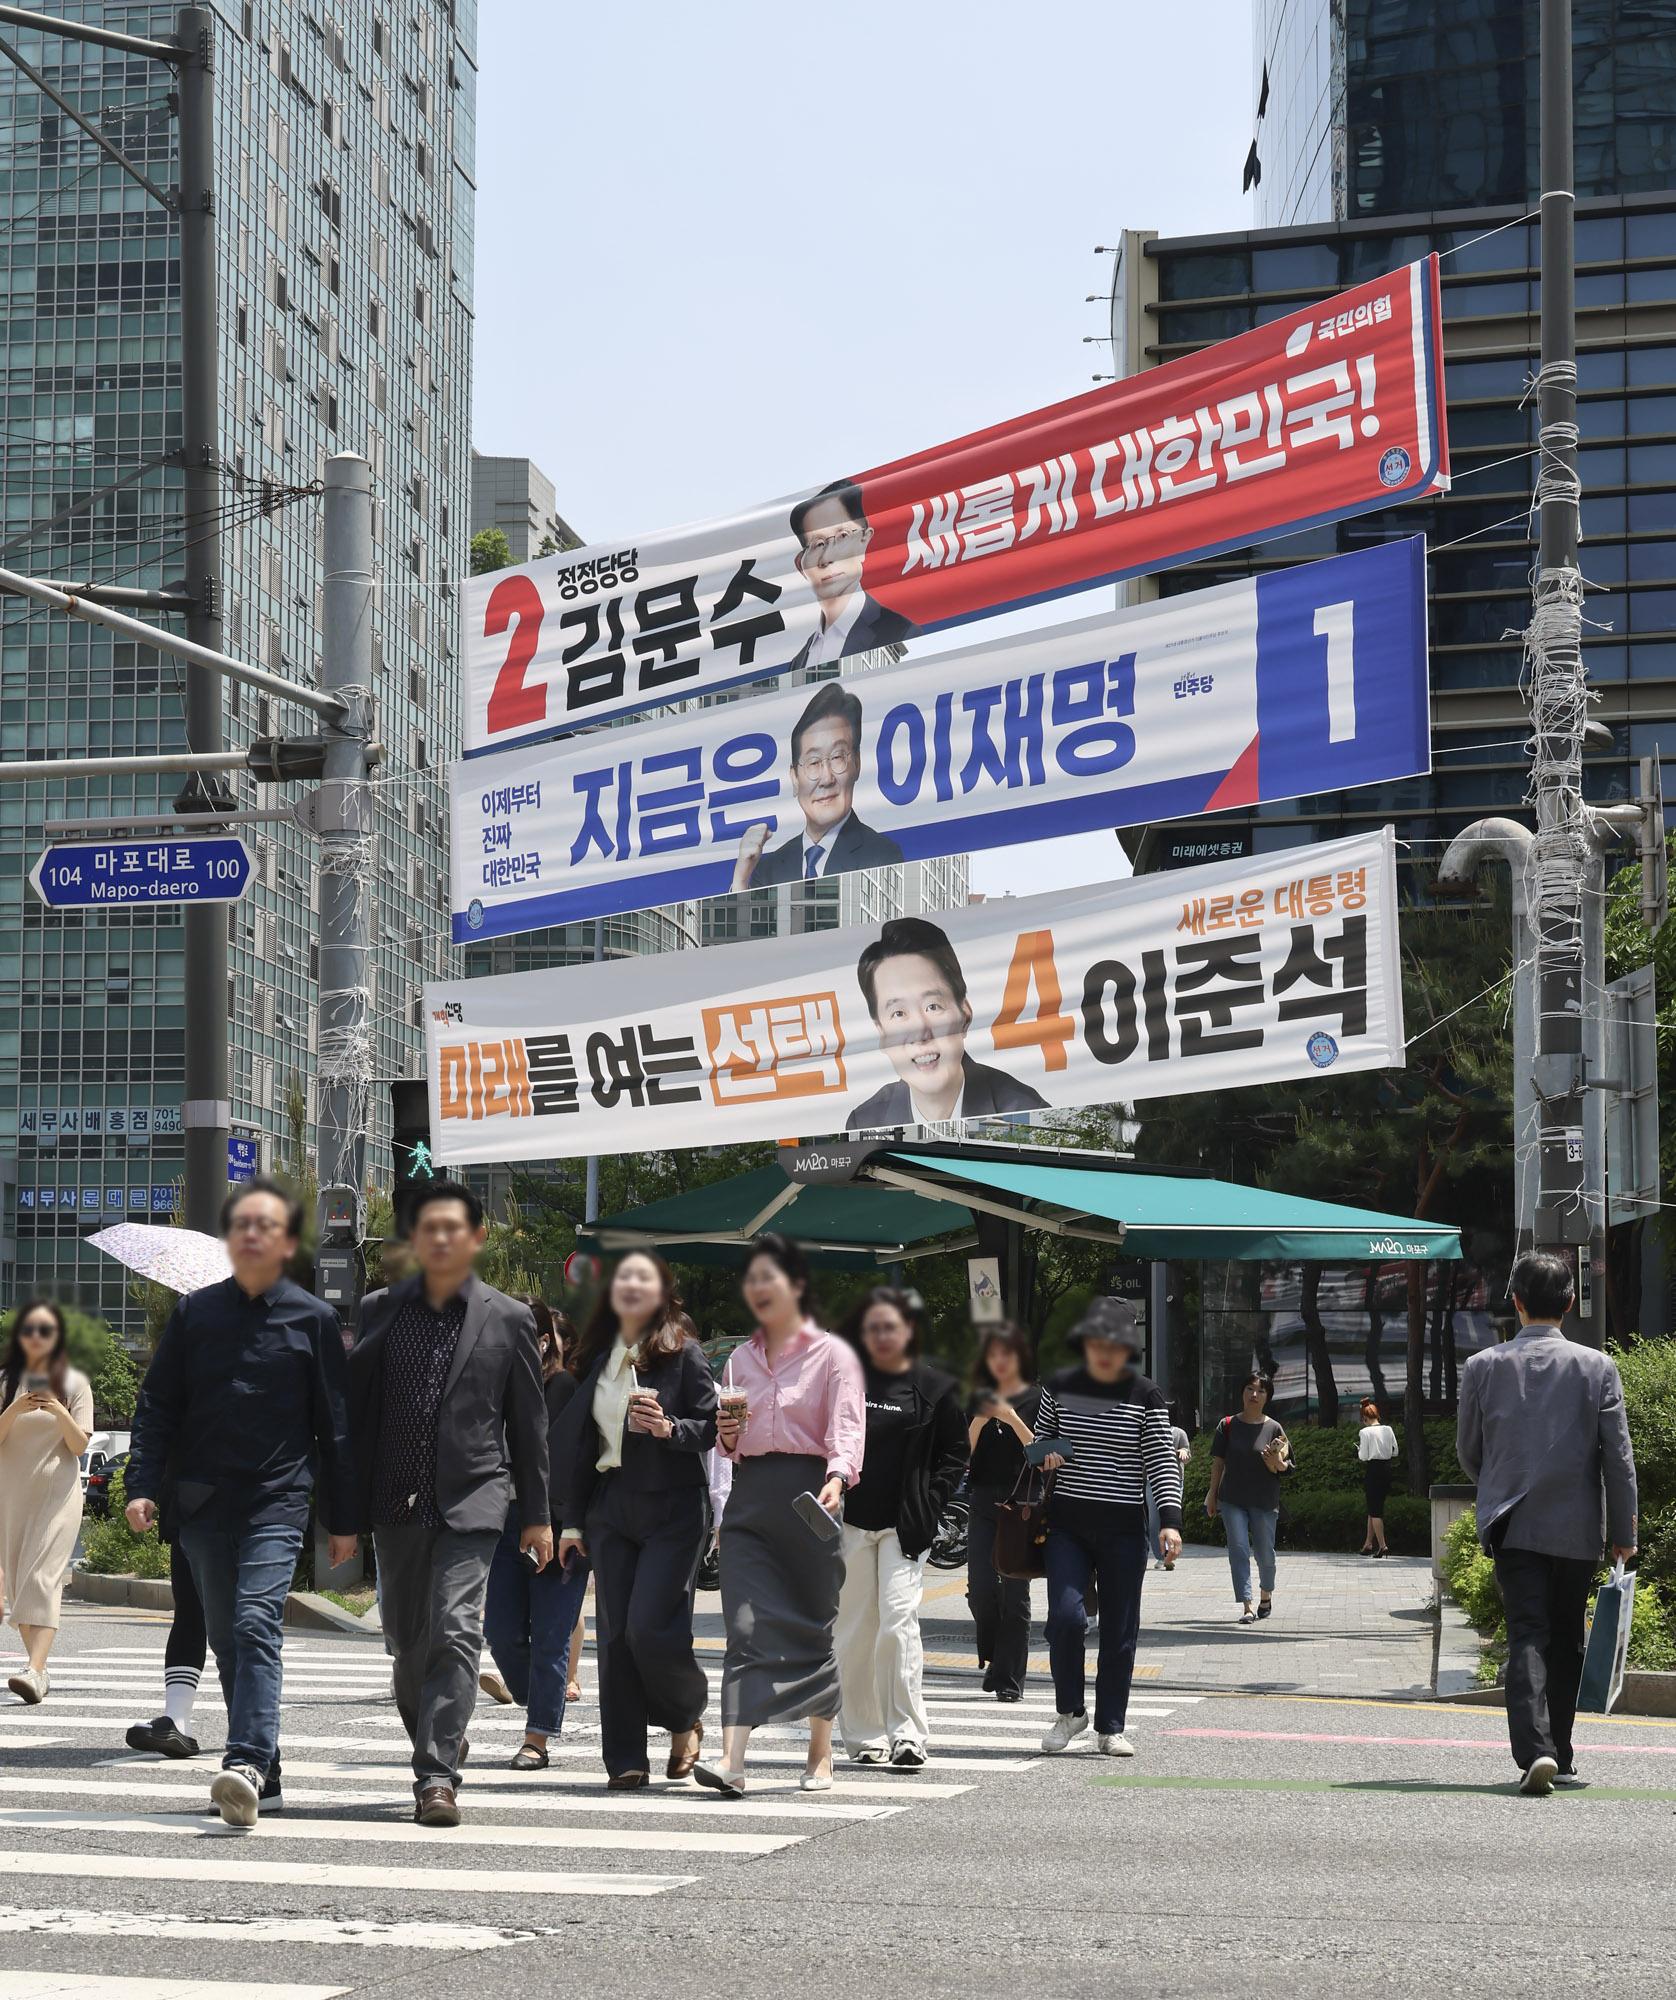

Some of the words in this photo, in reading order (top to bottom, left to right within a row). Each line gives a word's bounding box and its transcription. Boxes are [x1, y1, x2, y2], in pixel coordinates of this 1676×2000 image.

[1317, 294, 1392, 341] 국민의힘
[902, 453, 1079, 575] 새롭게
[1089, 355, 1381, 518] 대한민국!
[557, 548, 639, 600] 정정당당
[483, 575, 547, 735] 2
[560, 558, 786, 712] 김문수
[1173, 674, 1215, 700] 민주당
[1313, 600, 1357, 744] 1
[570, 733, 781, 867] 지금은
[876, 652, 1137, 807] 이재명
[481, 780, 542, 820] 이제부터
[482, 823, 513, 854] 진짜
[1172, 841, 1244, 858] 미래에셋증권
[49, 866, 83, 887] 104
[94, 847, 196, 876] 마포대로
[206, 859, 240, 880] 100
[482, 852, 542, 889] 대한민국
[91, 879, 200, 900] Mapo-daero
[1176, 888, 1265, 937] 새로운
[1273, 867, 1367, 920] 대통령
[991, 929, 1075, 1073] 4
[1081, 914, 1368, 1065] 이준석
[440, 1034, 580, 1121] 미래를
[586, 1023, 703, 1109] 여는
[711, 997, 842, 1100] 선택
[793, 1153, 829, 1172] MAPO
[831, 1156, 852, 1168] 마포구
[1369, 1237, 1406, 1255] MAPO
[1406, 1244, 1429, 1255] 마포구
